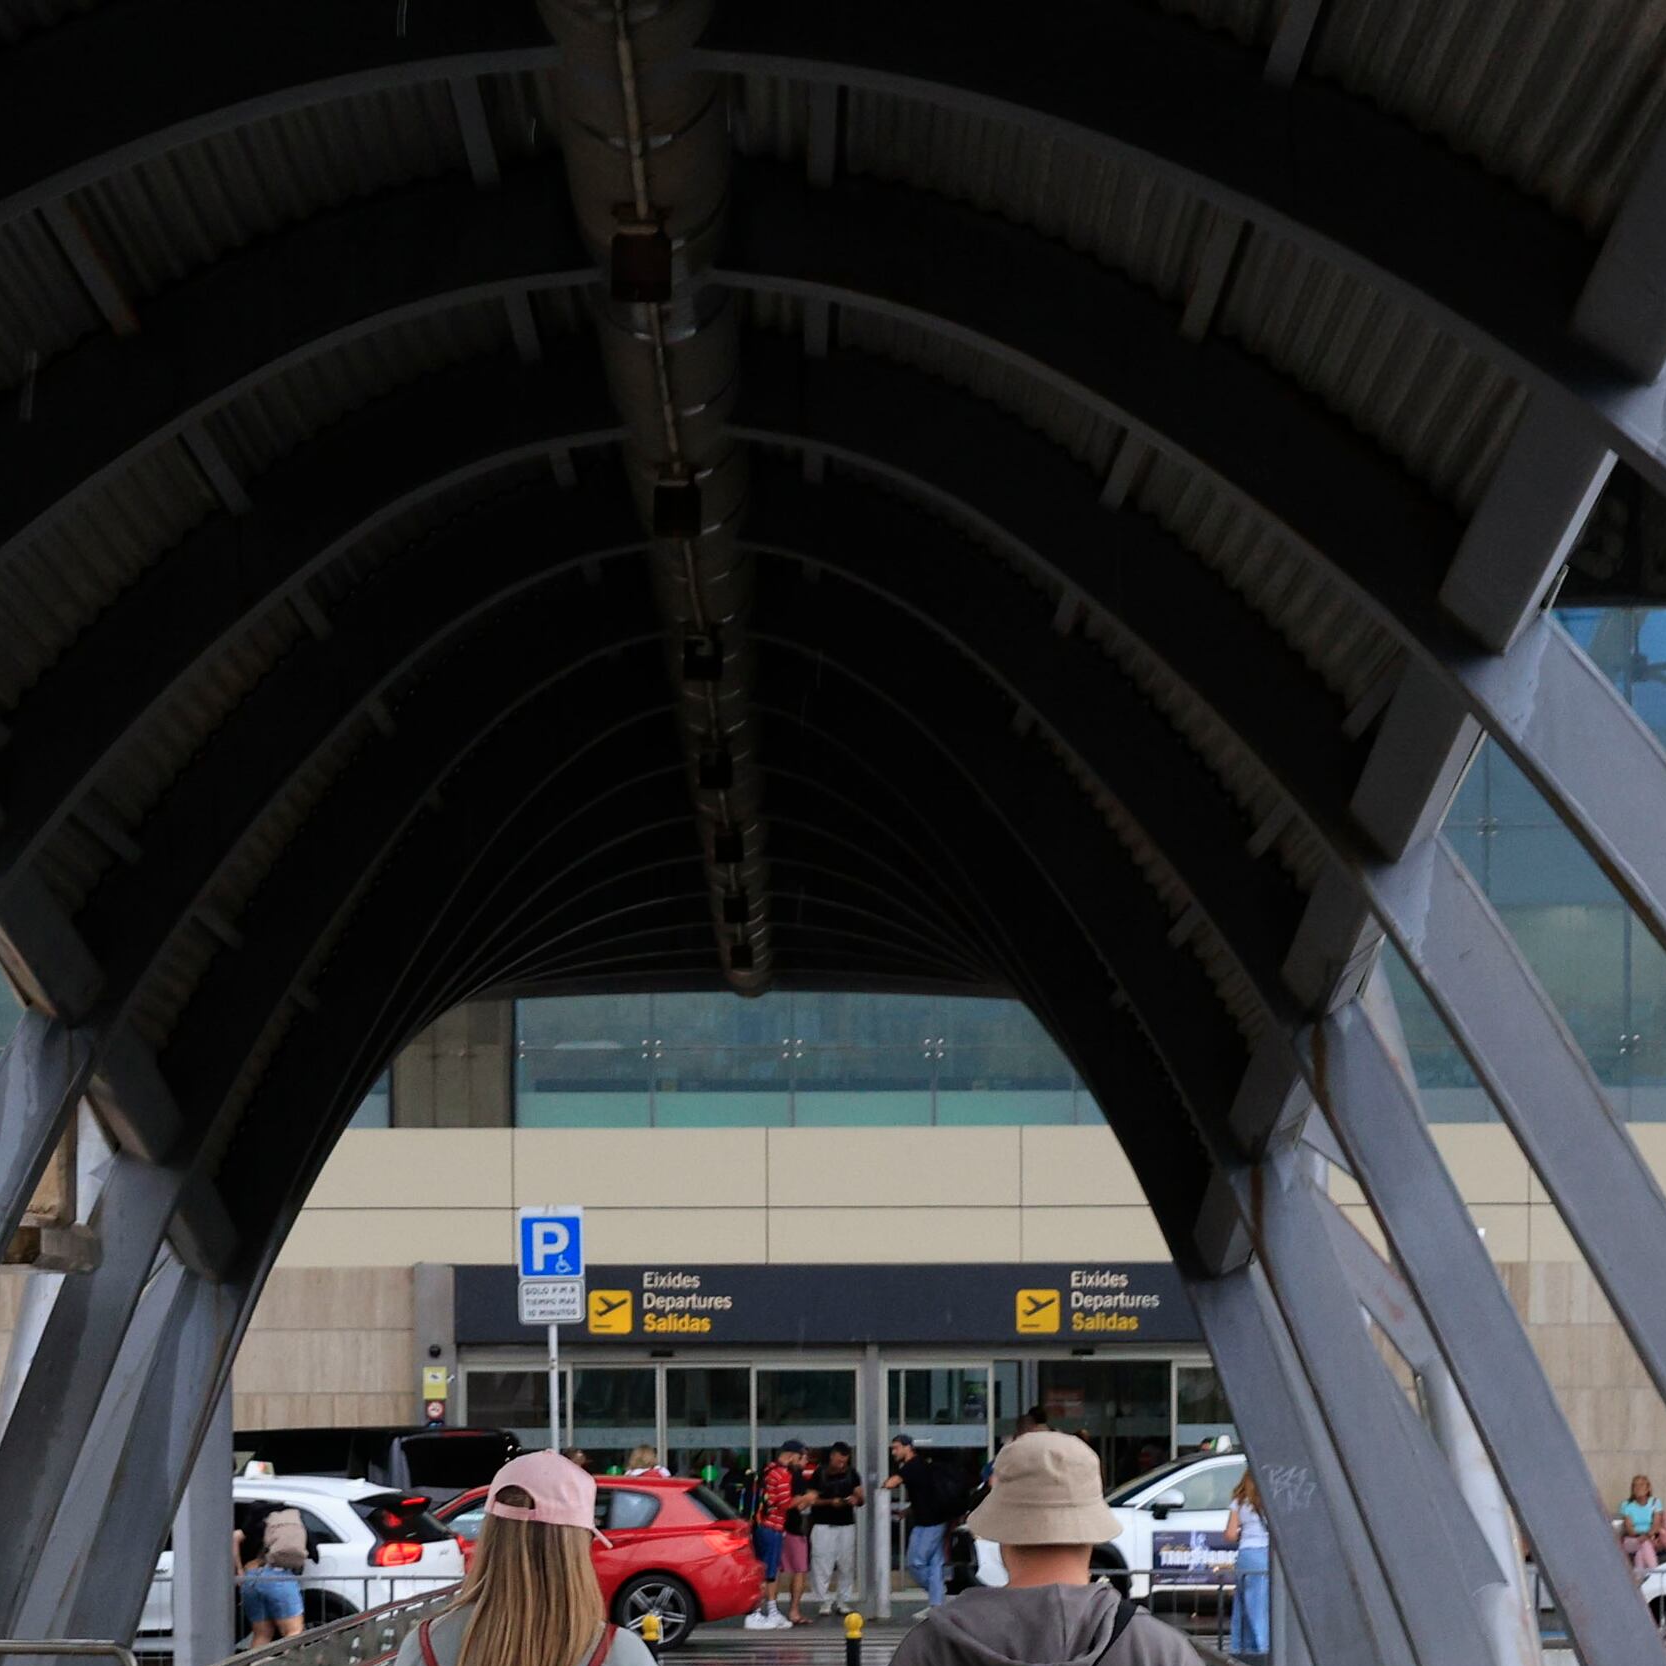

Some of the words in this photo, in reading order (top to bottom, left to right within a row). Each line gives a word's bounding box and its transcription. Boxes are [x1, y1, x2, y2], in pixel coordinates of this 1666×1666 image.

[532, 1221, 570, 1271] P
[642, 1271, 701, 1289] Eixides
[1070, 1270, 1129, 1289] Eixides
[525, 1286, 549, 1295] SOLO
[642, 1292, 733, 1312] Departures
[1070, 1291, 1160, 1312] Departures
[643, 1312, 712, 1332] Salidas
[1071, 1311, 1139, 1331] Salidas
